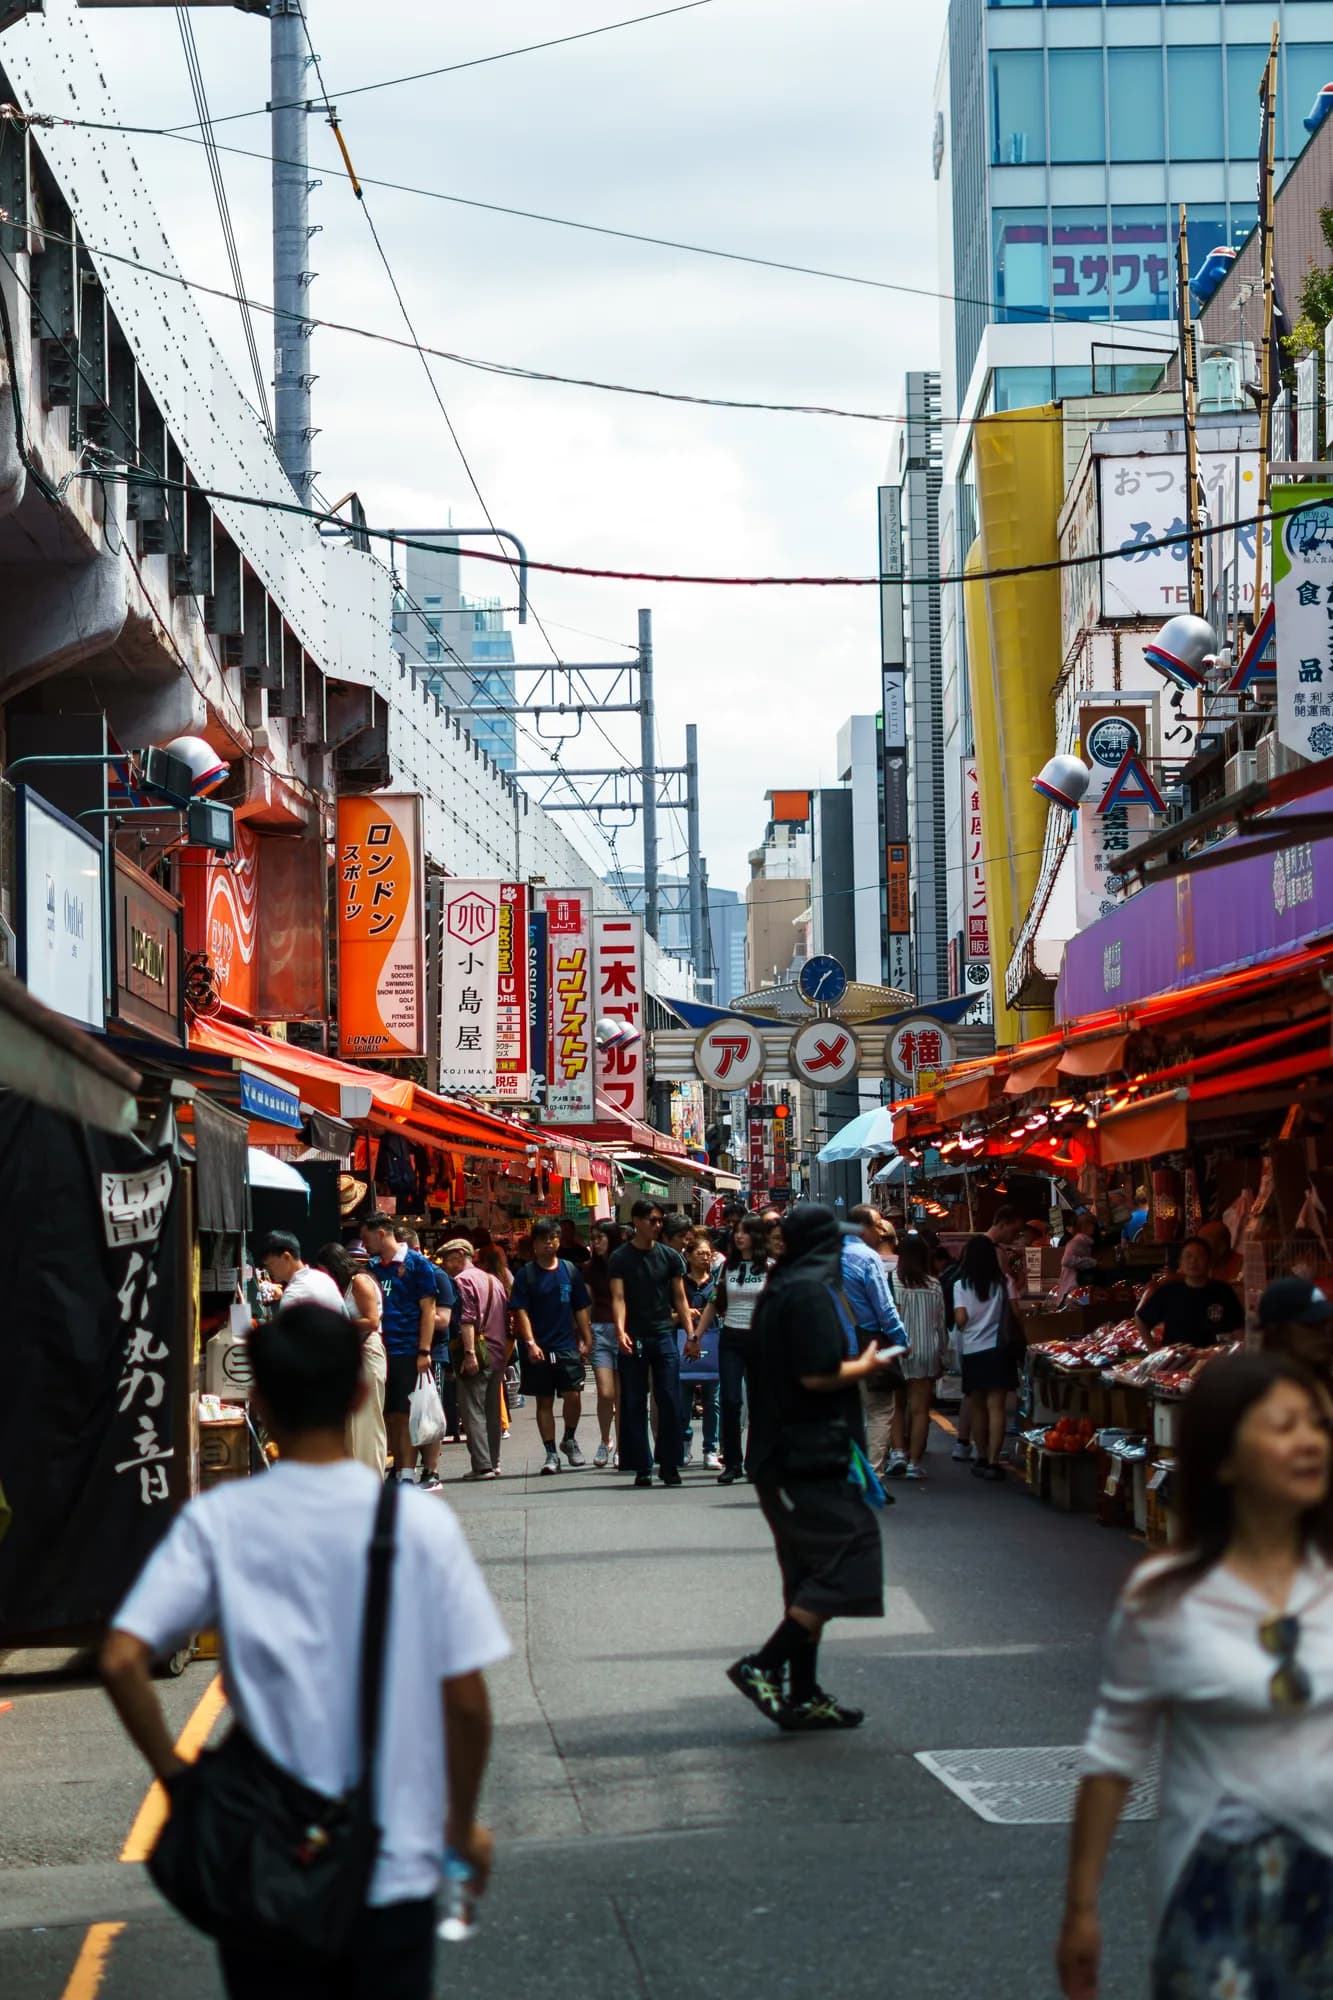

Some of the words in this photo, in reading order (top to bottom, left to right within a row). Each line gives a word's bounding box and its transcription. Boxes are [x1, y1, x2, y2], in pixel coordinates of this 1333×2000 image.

[1160, 586, 1192, 604] TE
[342, 845, 364, 920] スポーツ
[366, 823, 395, 935] ロンドン
[457, 952, 484, 1050] 小島屋
[557, 948, 587, 1080] JJTストア
[347, 1035, 389, 1045] LONDON
[710, 1028, 943, 1080] アメ横
